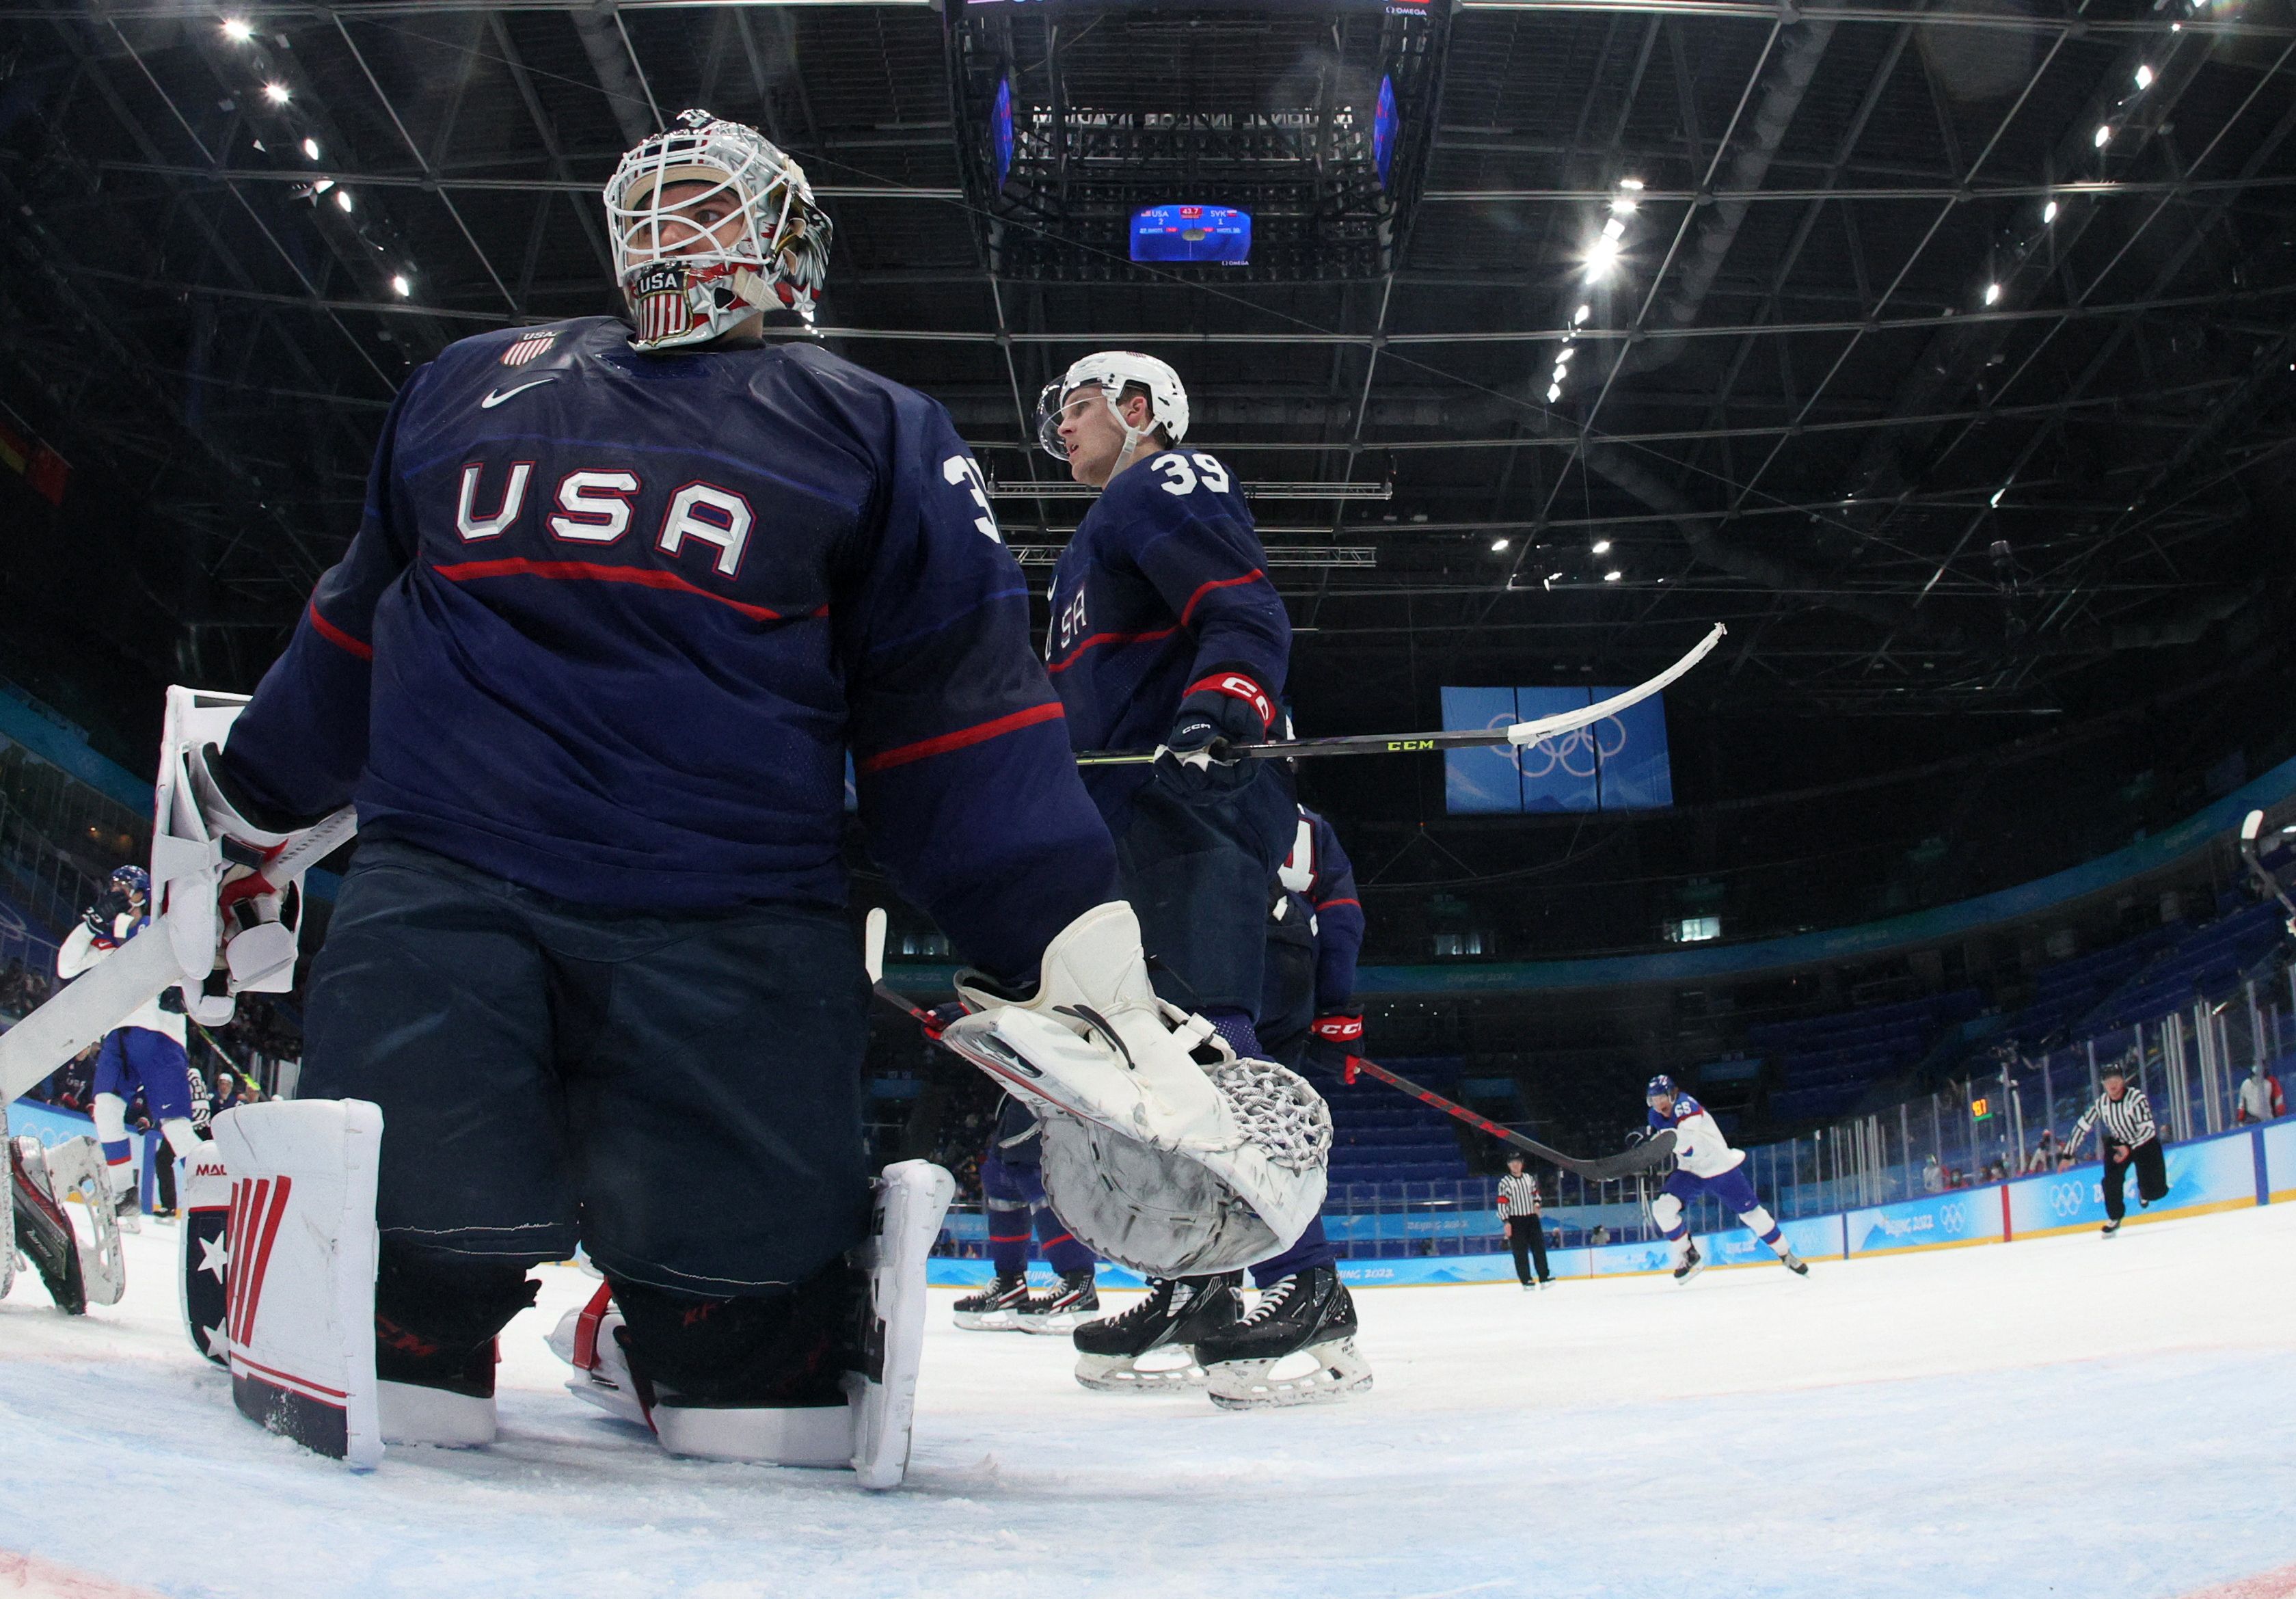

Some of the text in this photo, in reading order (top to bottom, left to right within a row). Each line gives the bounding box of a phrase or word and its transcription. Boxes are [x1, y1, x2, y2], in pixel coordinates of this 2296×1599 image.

[1396, 7, 1427, 16] OMEGA
[640, 272, 678, 293] USA
[523, 332, 558, 340] USA
[1150, 453, 1229, 496] 39
[455, 461, 757, 581] USA
[1182, 723, 1211, 734] CCM
[1388, 740, 1434, 751] CCM
